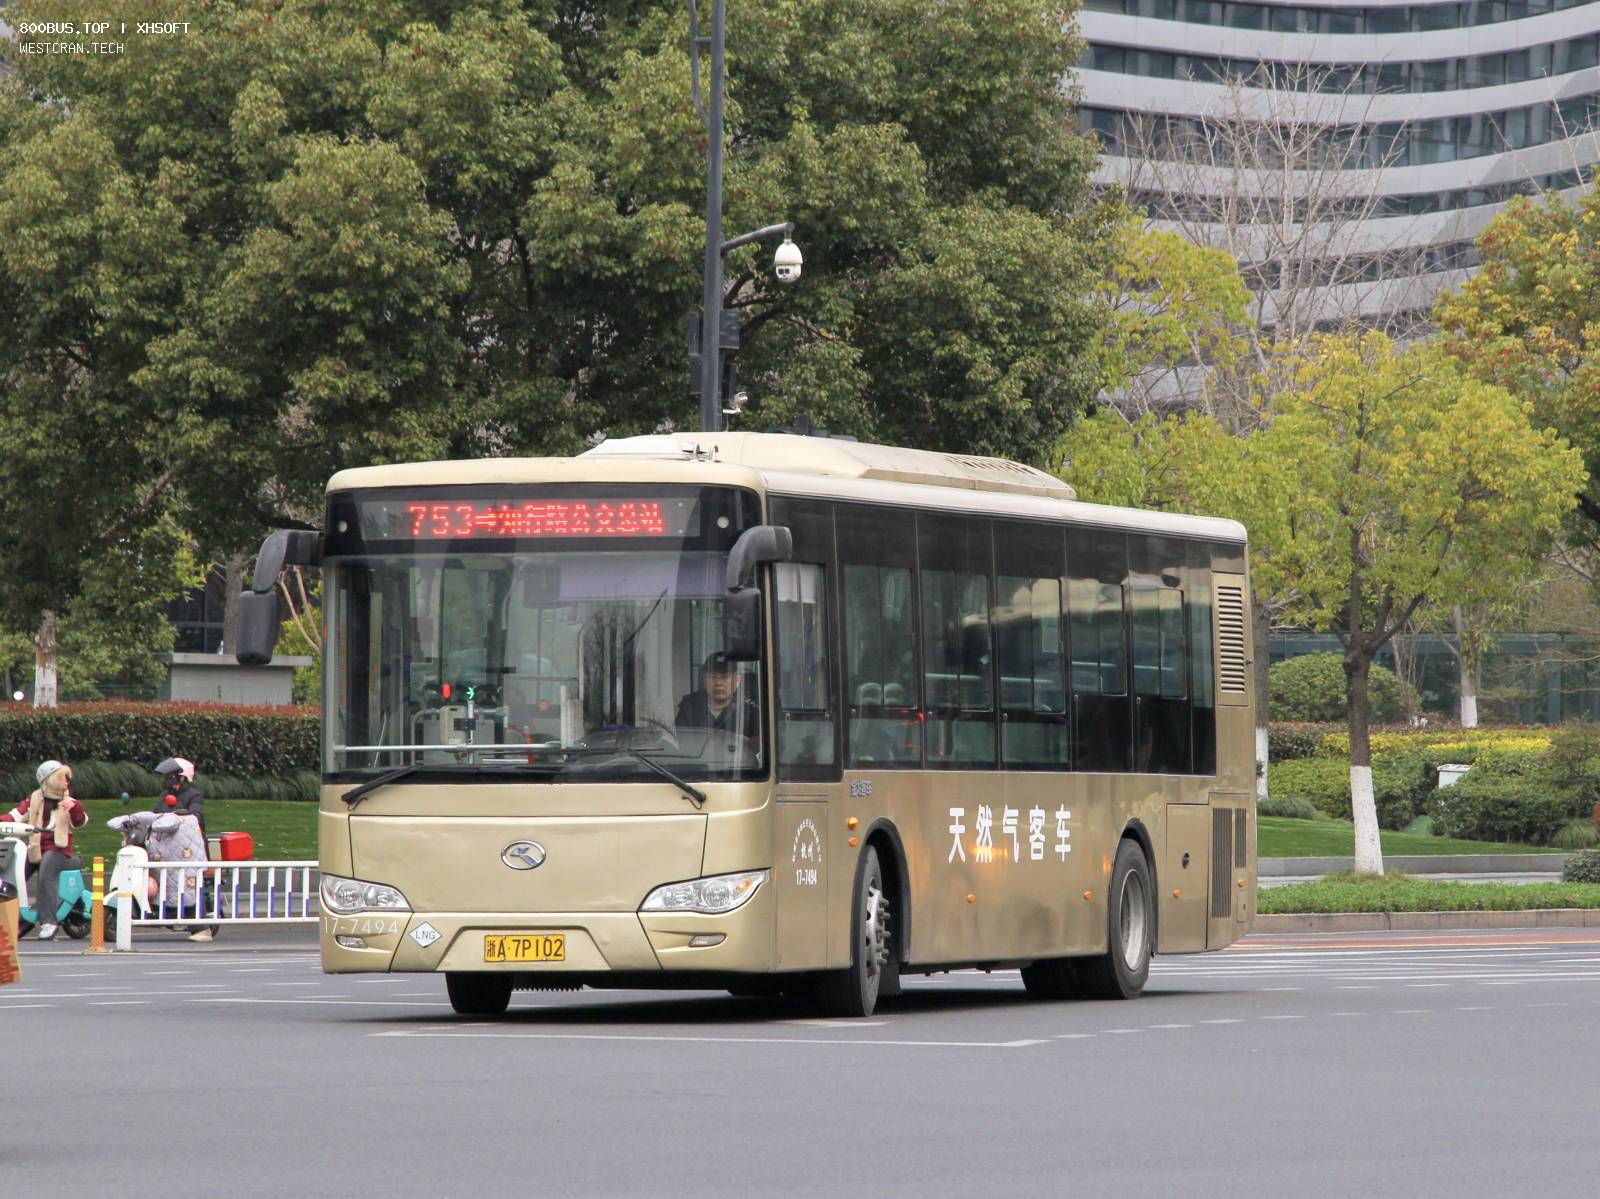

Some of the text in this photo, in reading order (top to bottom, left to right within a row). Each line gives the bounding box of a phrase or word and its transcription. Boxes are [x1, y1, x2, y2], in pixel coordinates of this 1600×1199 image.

[408, 506, 474, 536] 753
[948, 803, 1072, 864] 天然气客车
[323, 917, 399, 935] 17-7494
[415, 930, 436, 941] LNG
